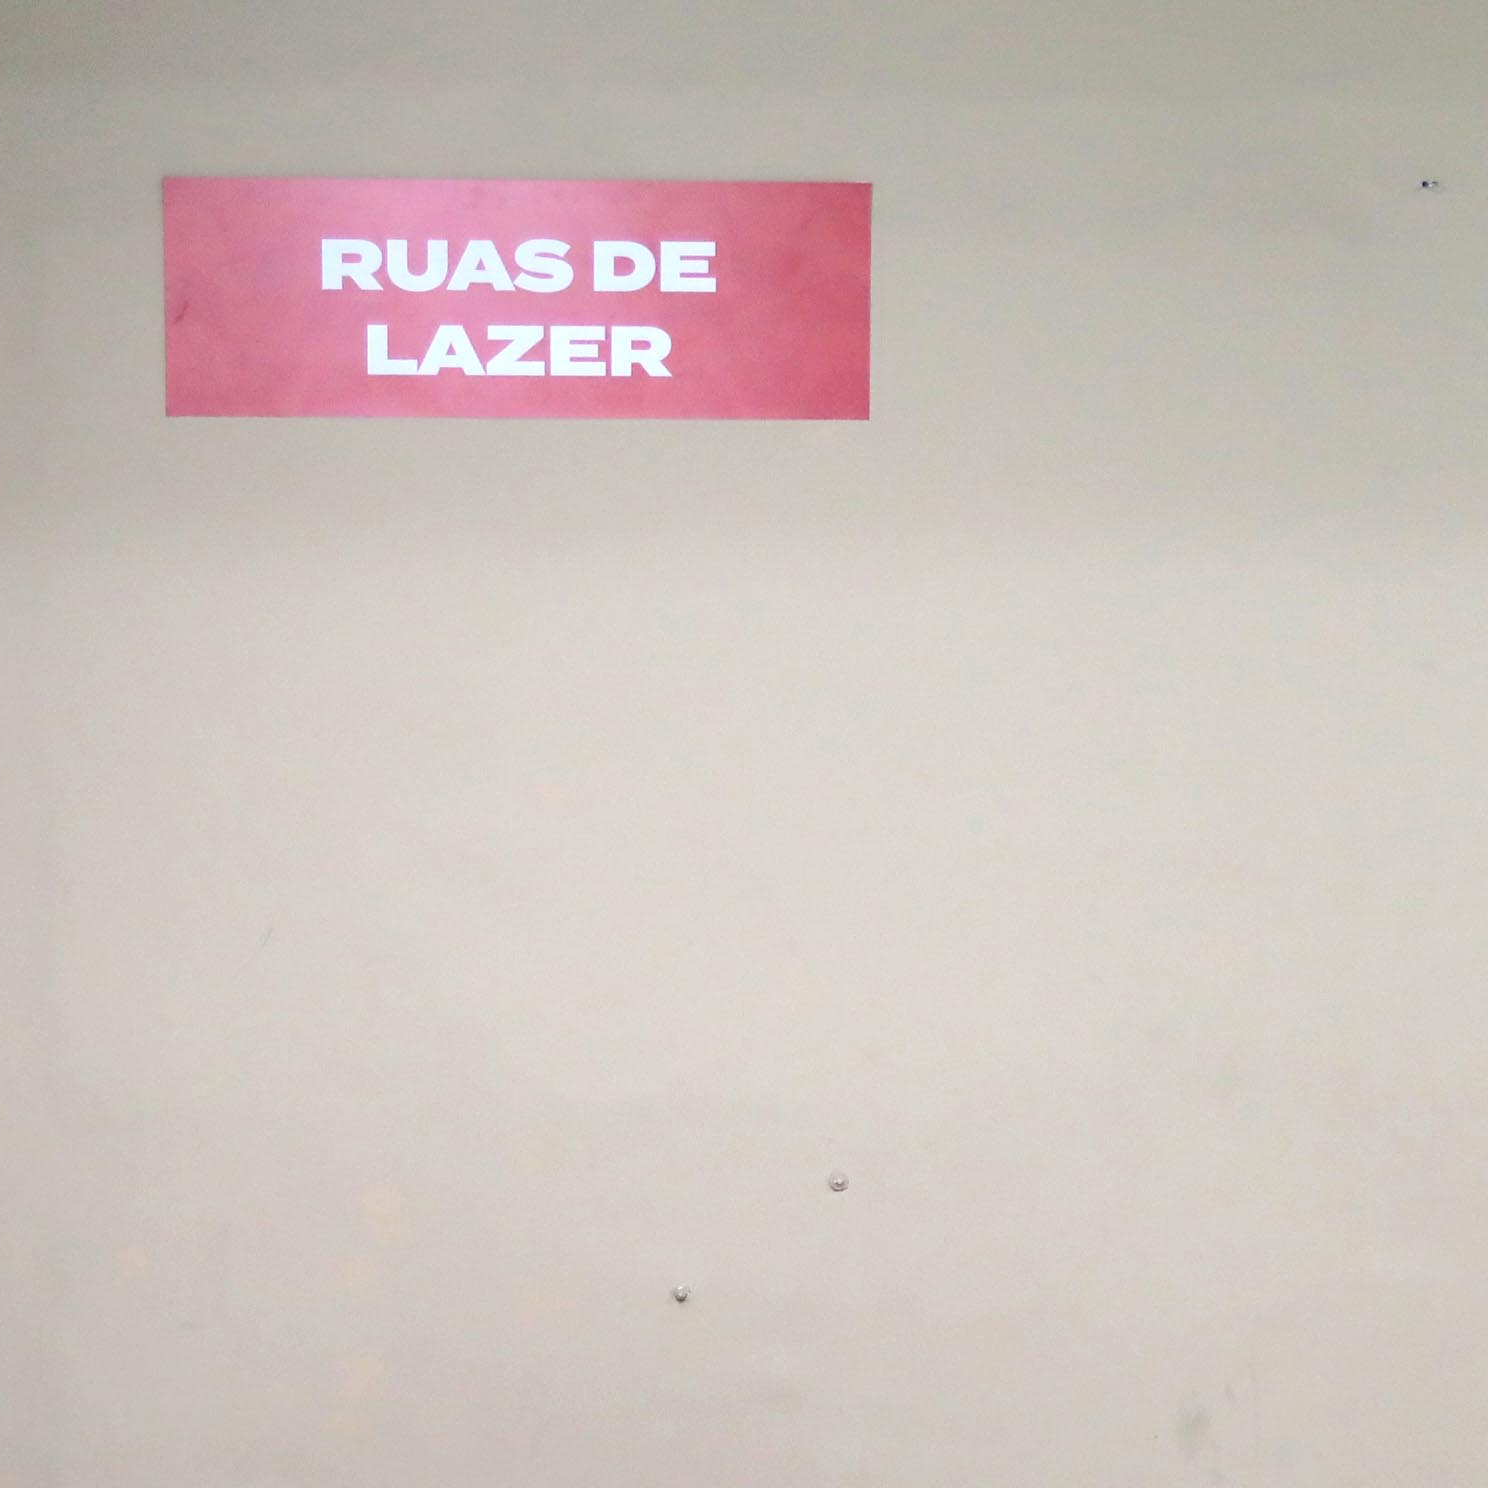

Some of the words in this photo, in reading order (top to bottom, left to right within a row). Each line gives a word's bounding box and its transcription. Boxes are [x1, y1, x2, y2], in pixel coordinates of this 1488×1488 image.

[321, 237, 574, 293] RUAS
[592, 240, 717, 293] DE
[366, 323, 673, 378] LAZER
